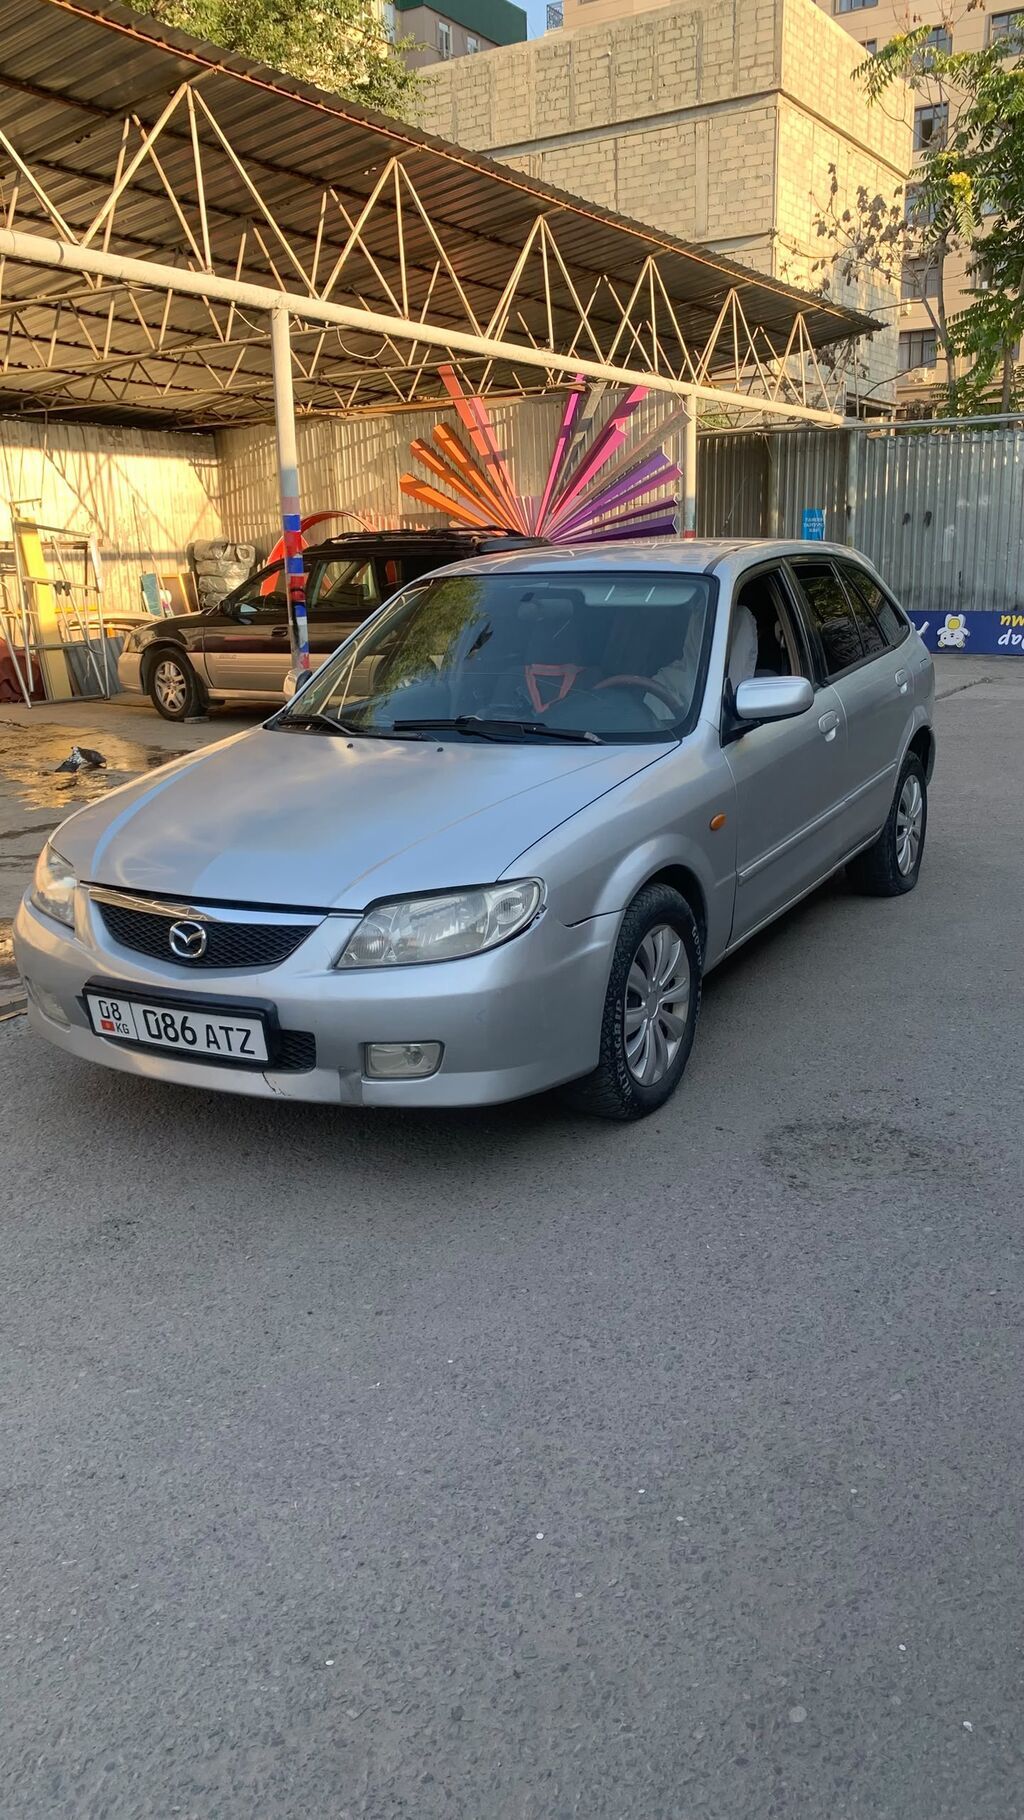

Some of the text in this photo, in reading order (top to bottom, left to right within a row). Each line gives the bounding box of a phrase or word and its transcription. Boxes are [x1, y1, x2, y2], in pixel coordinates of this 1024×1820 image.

[997, 629, 1024, 650] ар
[98, 1000, 255, 1055] 08 086 ATZ
[116, 1021, 130, 1035] KG
